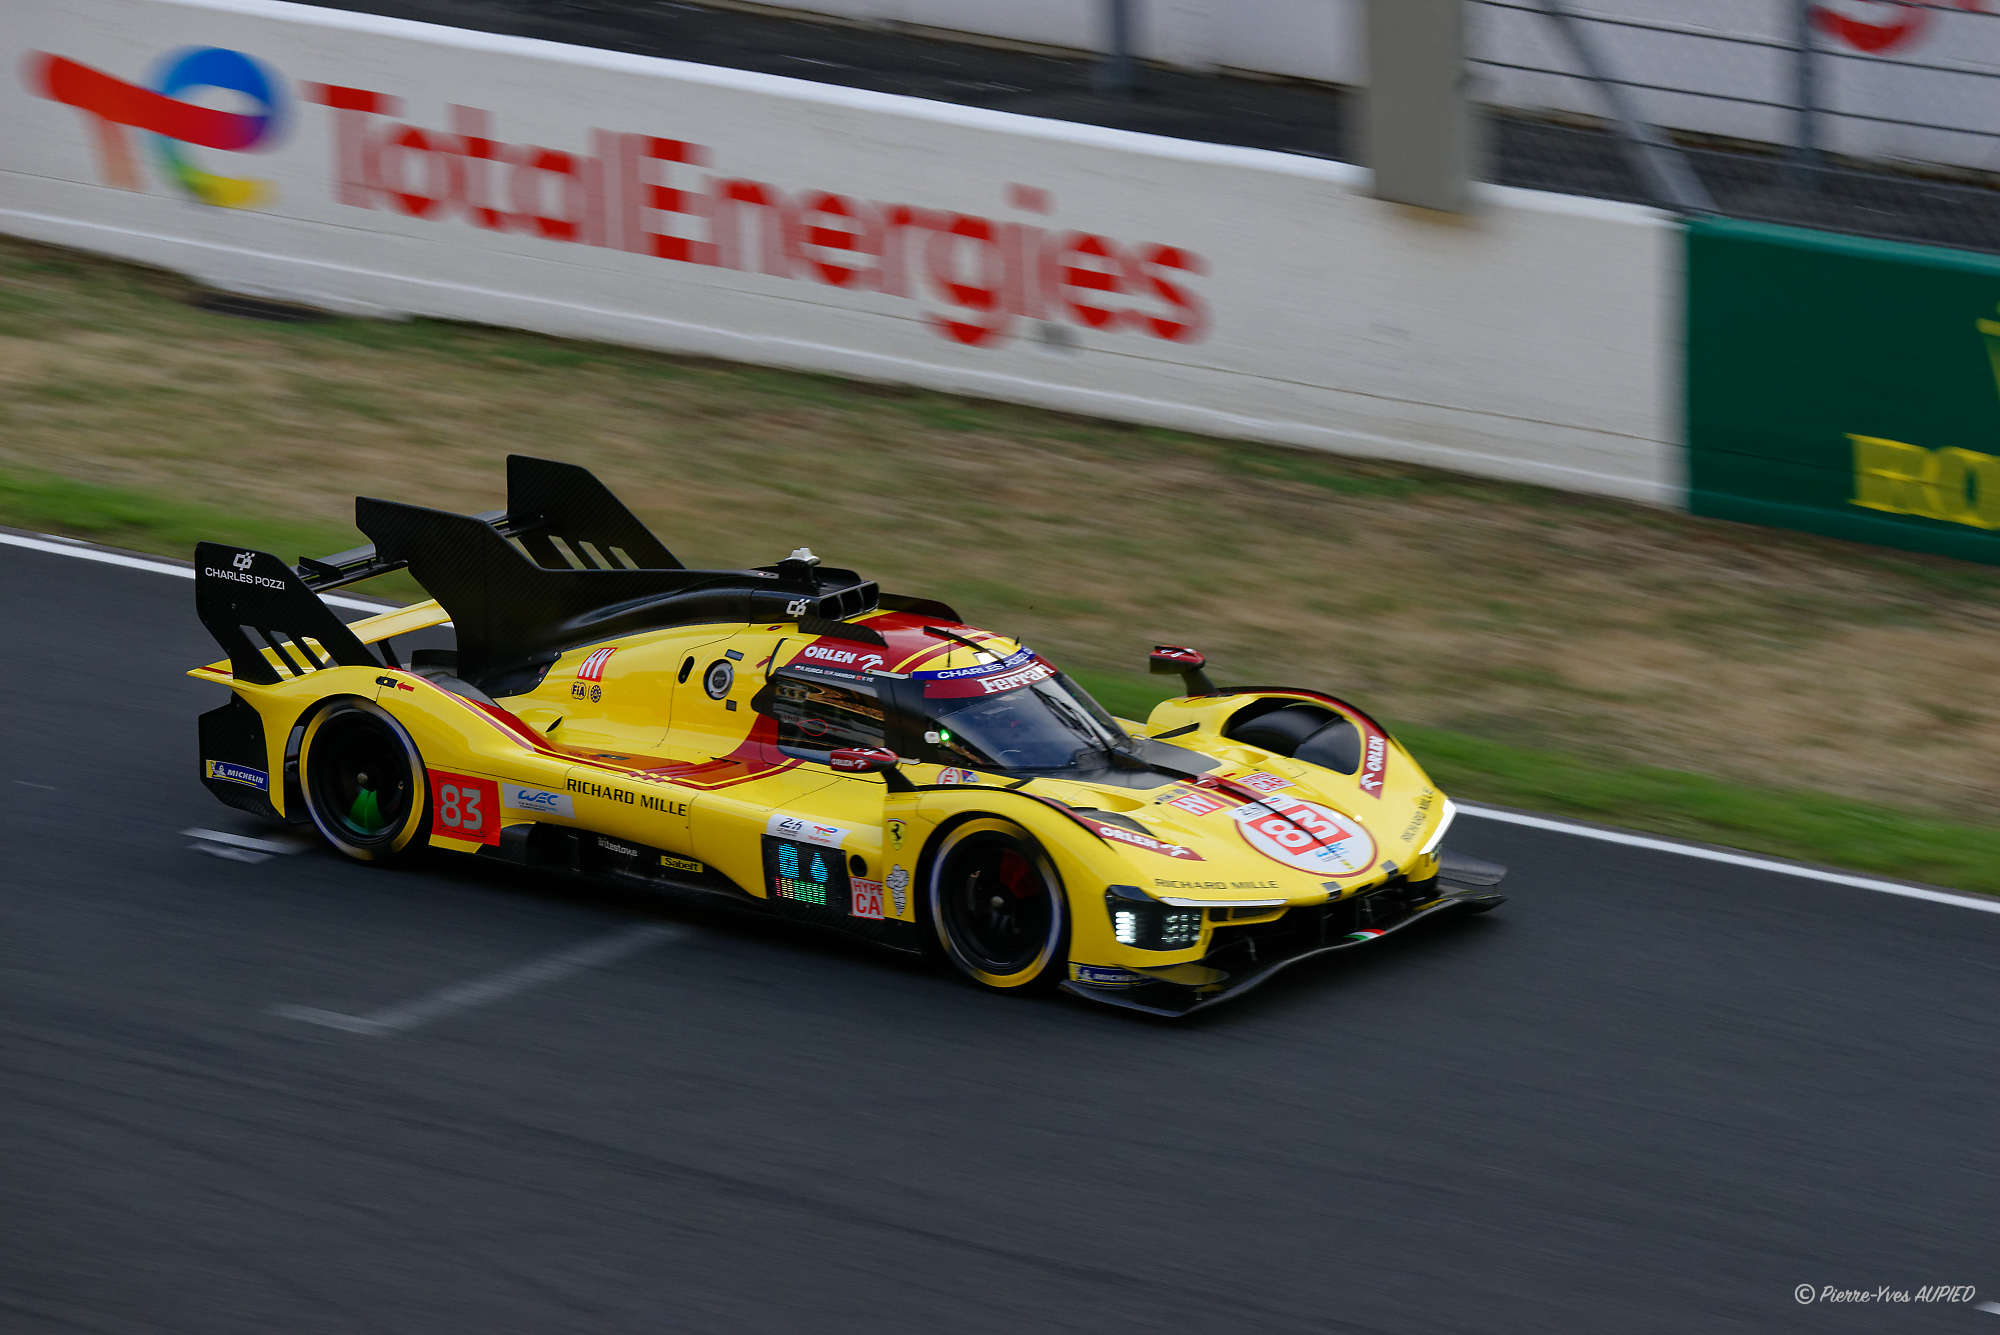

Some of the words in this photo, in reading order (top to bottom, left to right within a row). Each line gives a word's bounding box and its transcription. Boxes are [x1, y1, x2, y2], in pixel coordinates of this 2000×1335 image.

[303, 79, 1211, 346] TotalEnergies
[205, 567, 253, 584] CHARLES
[254, 575, 285, 590] POZZI
[804, 645, 857, 664] ORLEN
[937, 662, 1004, 680] CHARLES
[227, 769, 264, 784] MICHELIN
[441, 783, 483, 830] 83
[567, 778, 635, 805] RICHARD
[640, 795, 688, 817] MILLE
[1260, 809, 1340, 848] 83
